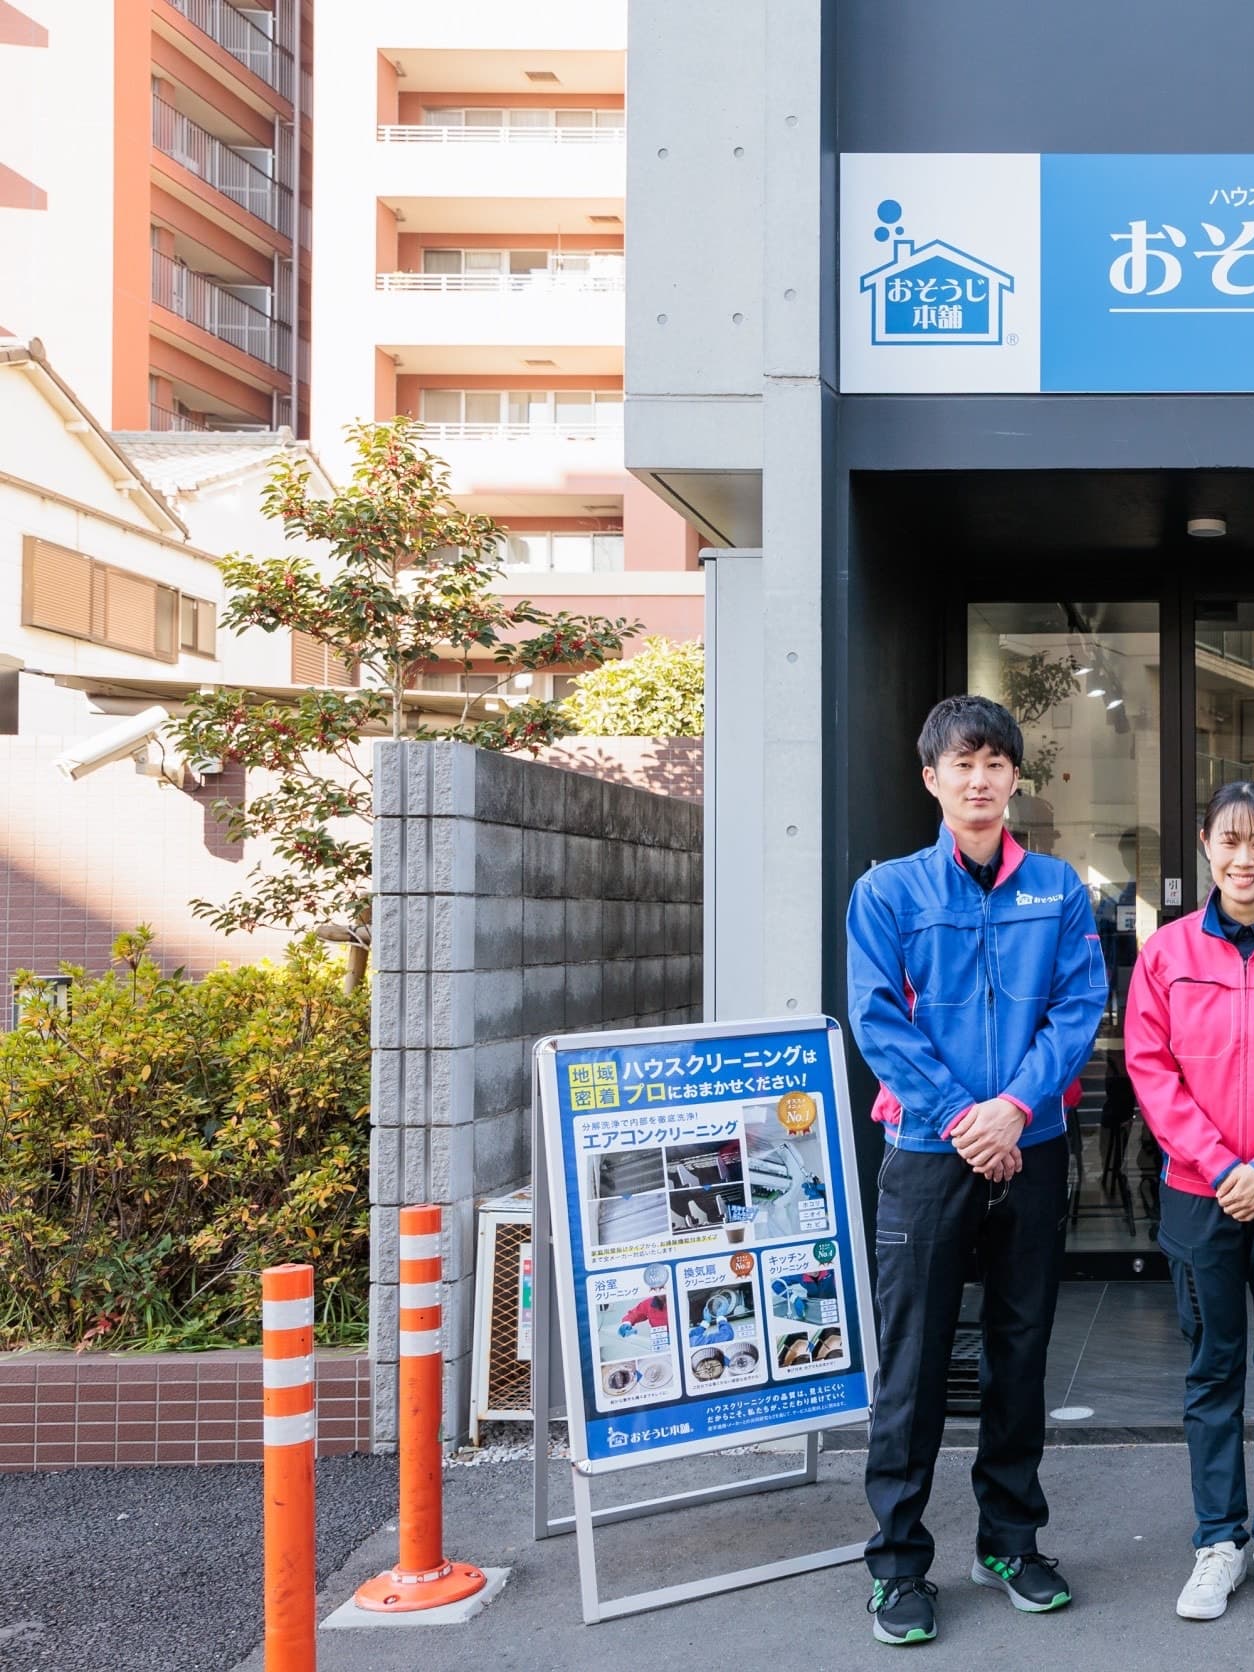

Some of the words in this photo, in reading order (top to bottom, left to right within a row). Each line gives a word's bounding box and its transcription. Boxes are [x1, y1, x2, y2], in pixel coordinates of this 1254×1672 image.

[887, 278, 987, 303] おそうじ
[912, 304, 963, 329] 本舗
[623, 1045, 817, 1081] ハウスクリーニングは
[572, 1064, 615, 1084] 地域
[574, 1086, 617, 1107] 密着
[624, 1073, 808, 1104] プロにおまかせください!
[582, 1119, 738, 1149] エアコンクリーニング
[768, 1252, 807, 1266] キッチン
[769, 1262, 810, 1275] クリーニング
[684, 1264, 716, 1279] 換気扇
[685, 1274, 727, 1288] クリーニング
[594, 1278, 618, 1292] 浴室
[595, 1287, 640, 1301] クリーニング
